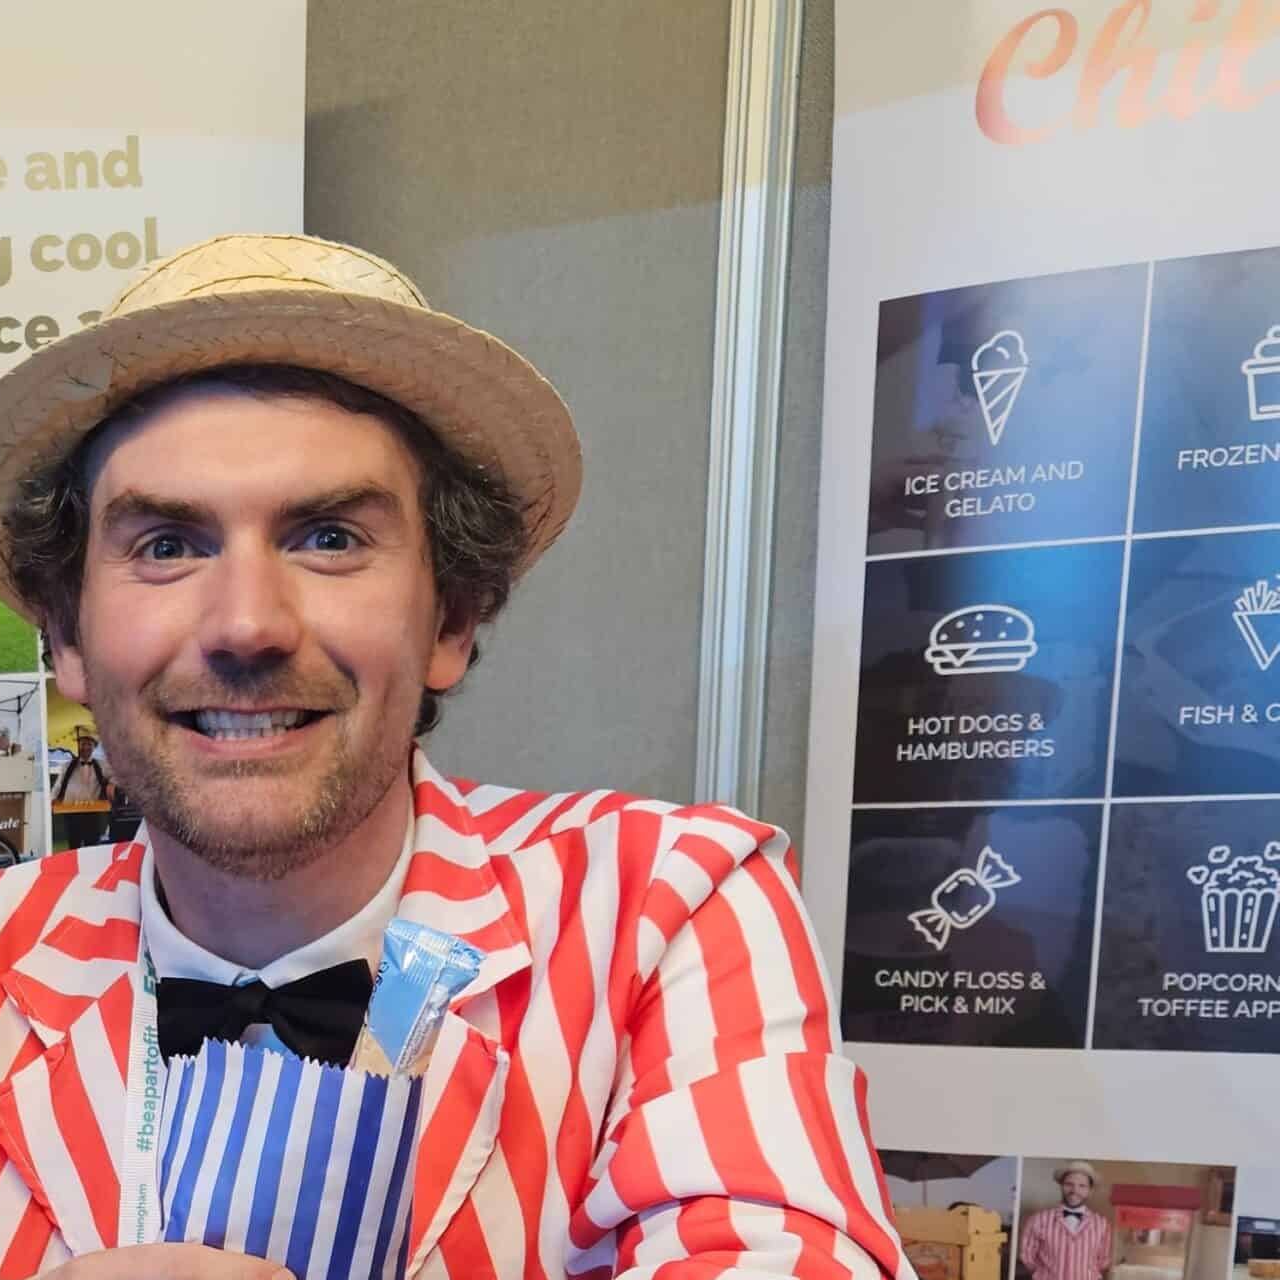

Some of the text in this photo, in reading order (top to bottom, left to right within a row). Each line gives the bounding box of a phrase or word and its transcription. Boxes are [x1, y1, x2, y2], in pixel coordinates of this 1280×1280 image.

[975, 0, 1280, 144] Chil
[24, 136, 144, 191] and
[29, 219, 162, 273] cool
[1177, 442, 1280, 471] FROZEN
[905, 460, 1084, 496] ICE CREAM AND
[945, 493, 1036, 518] GELATO
[908, 713, 1046, 736] HOT DOGS &
[1178, 703, 1235, 725] FISH
[1240, 703, 1259, 723] &
[896, 739, 1055, 762] HAMBURGERS
[875, 970, 1046, 990] CANDY FLOSS &
[1162, 972, 1280, 993] POPCORN
[901, 995, 1016, 1015] PICK & MIX
[1137, 998, 1229, 1018] TOFFEE
[135, 1024, 163, 1153] #beapartofit
